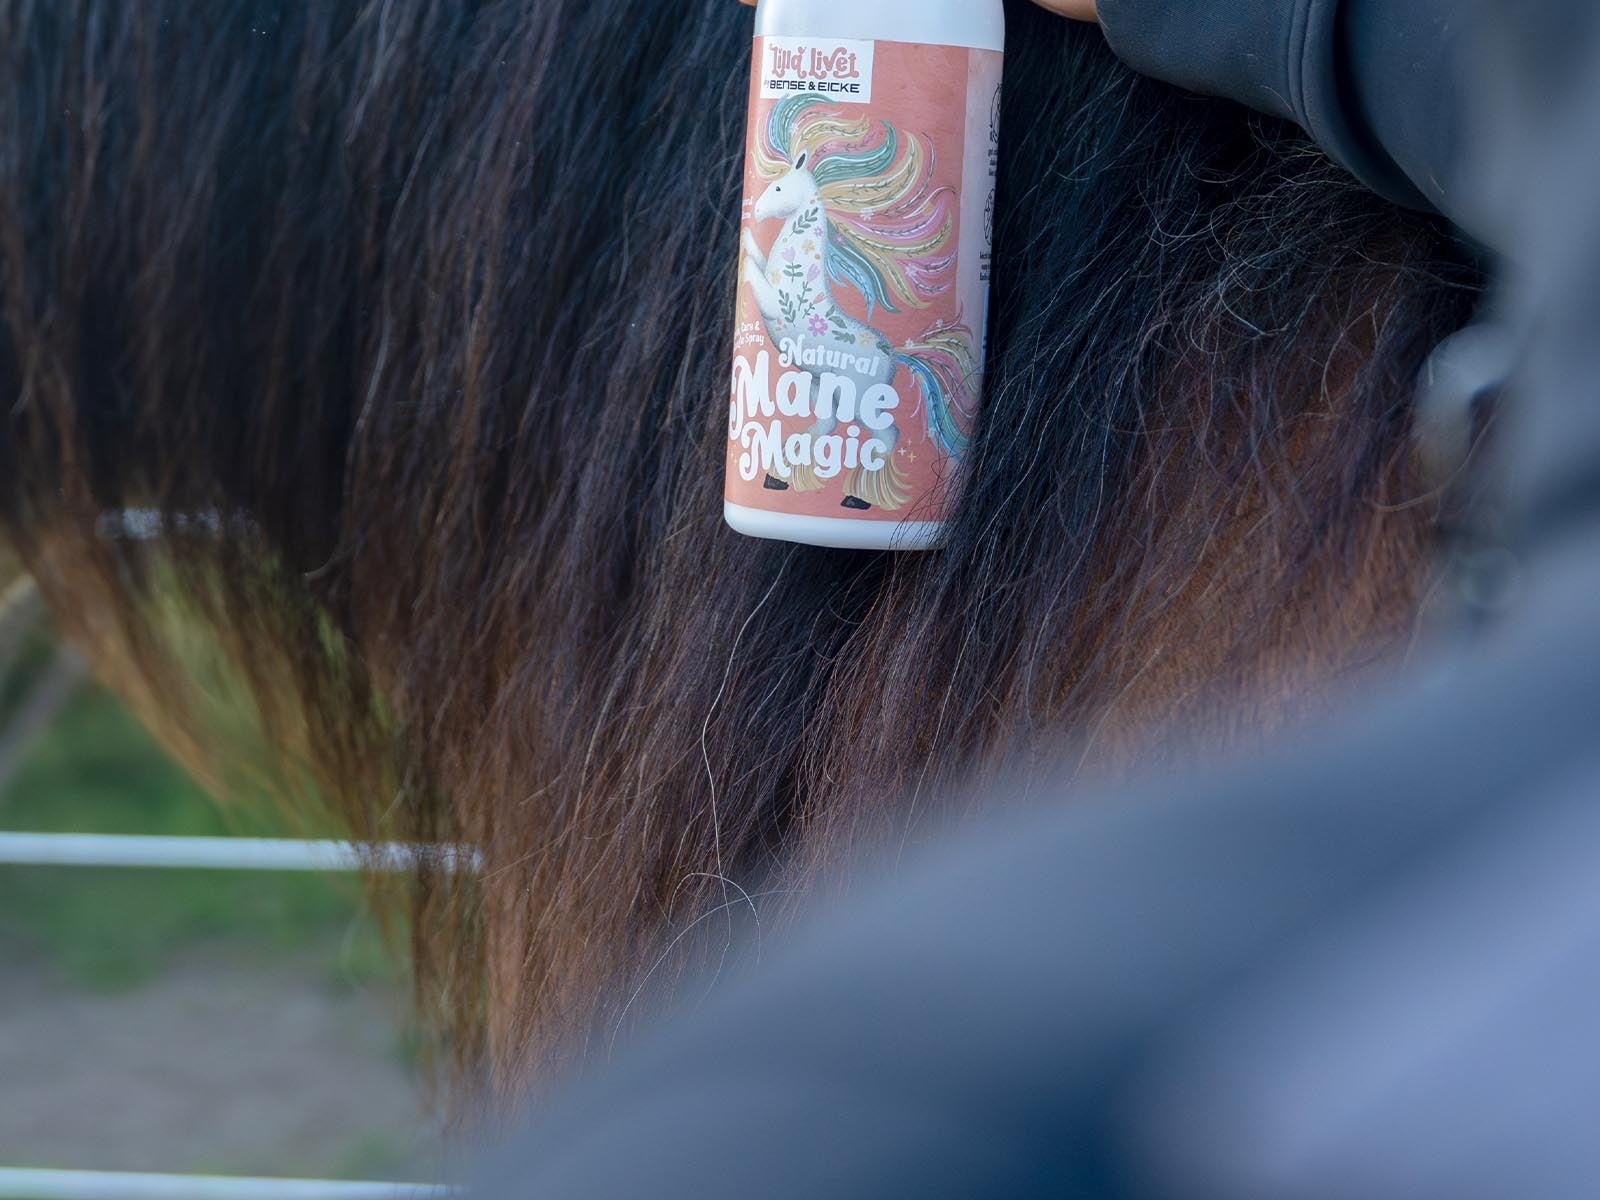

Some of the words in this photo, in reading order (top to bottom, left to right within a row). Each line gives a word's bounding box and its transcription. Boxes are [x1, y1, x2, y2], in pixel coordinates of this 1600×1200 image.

[769, 79, 806, 90] BENSE
[809, 81, 816, 91] &
[817, 81, 861, 94] EICKE
[745, 332, 765, 347] Spray
[778, 334, 881, 377] Natural
[729, 350, 900, 441] Mane
[738, 419, 888, 481] Magic
